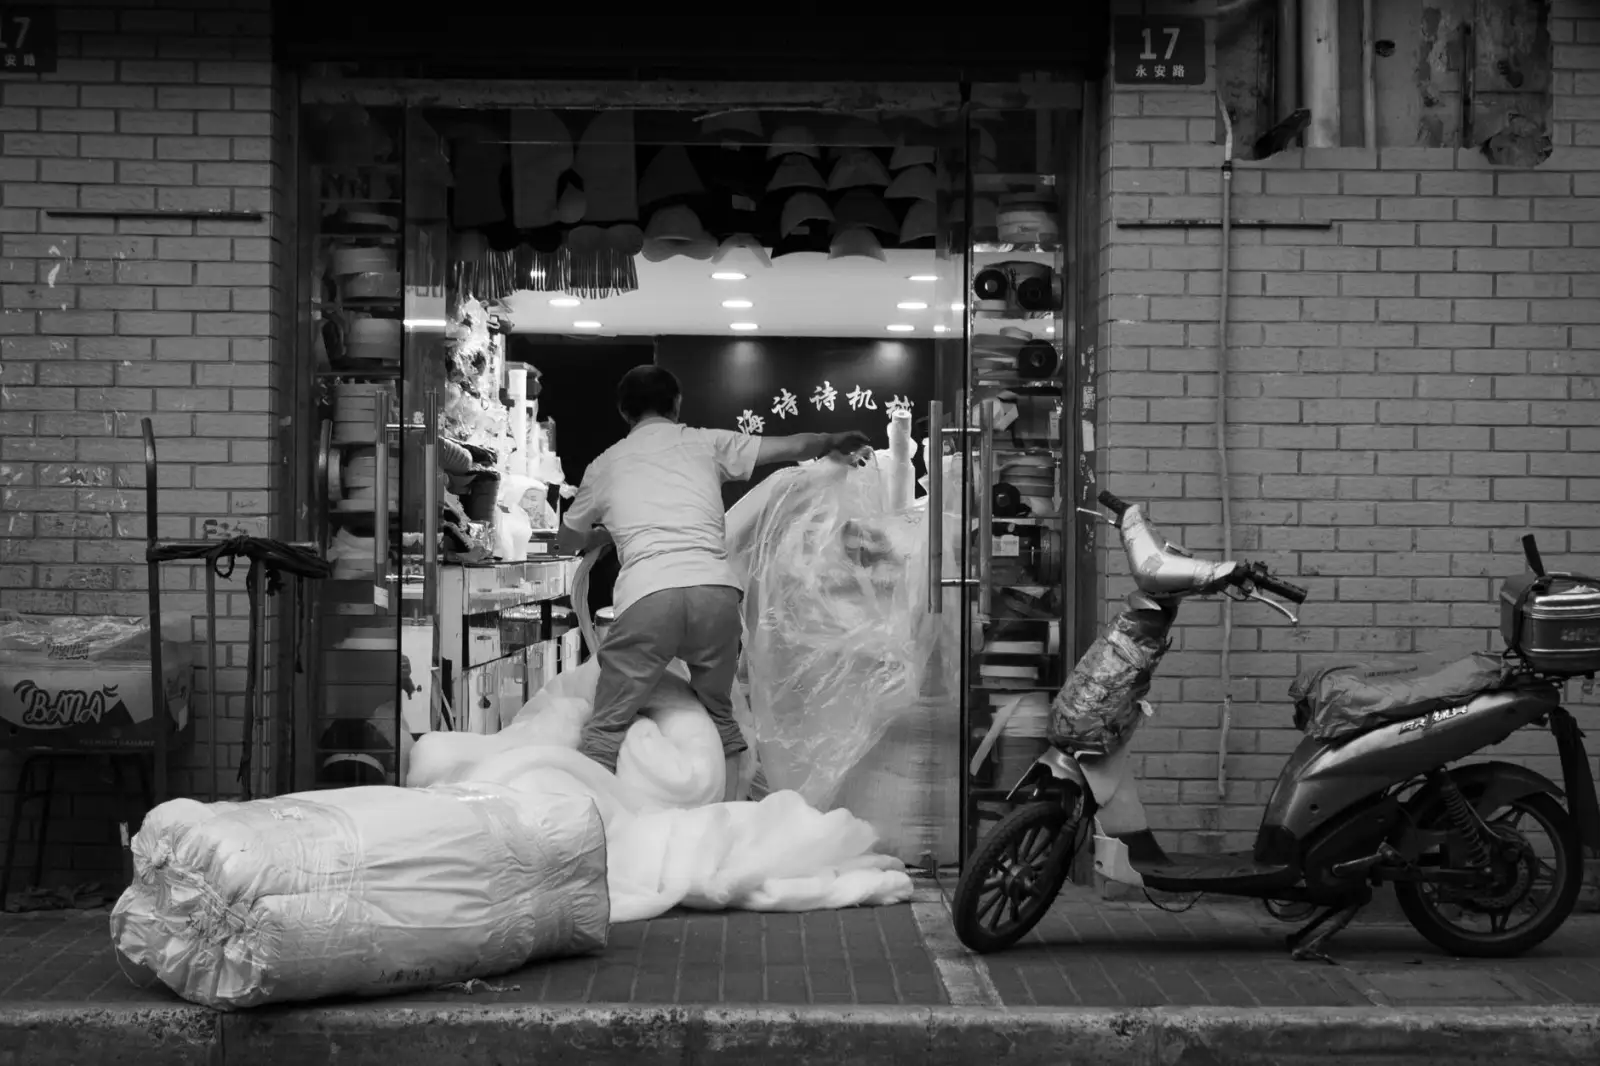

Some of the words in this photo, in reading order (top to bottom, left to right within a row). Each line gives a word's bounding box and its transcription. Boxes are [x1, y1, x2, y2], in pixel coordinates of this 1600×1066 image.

[1139, 27, 1180, 60] 17
[1135, 63, 1185, 78] 永安路
